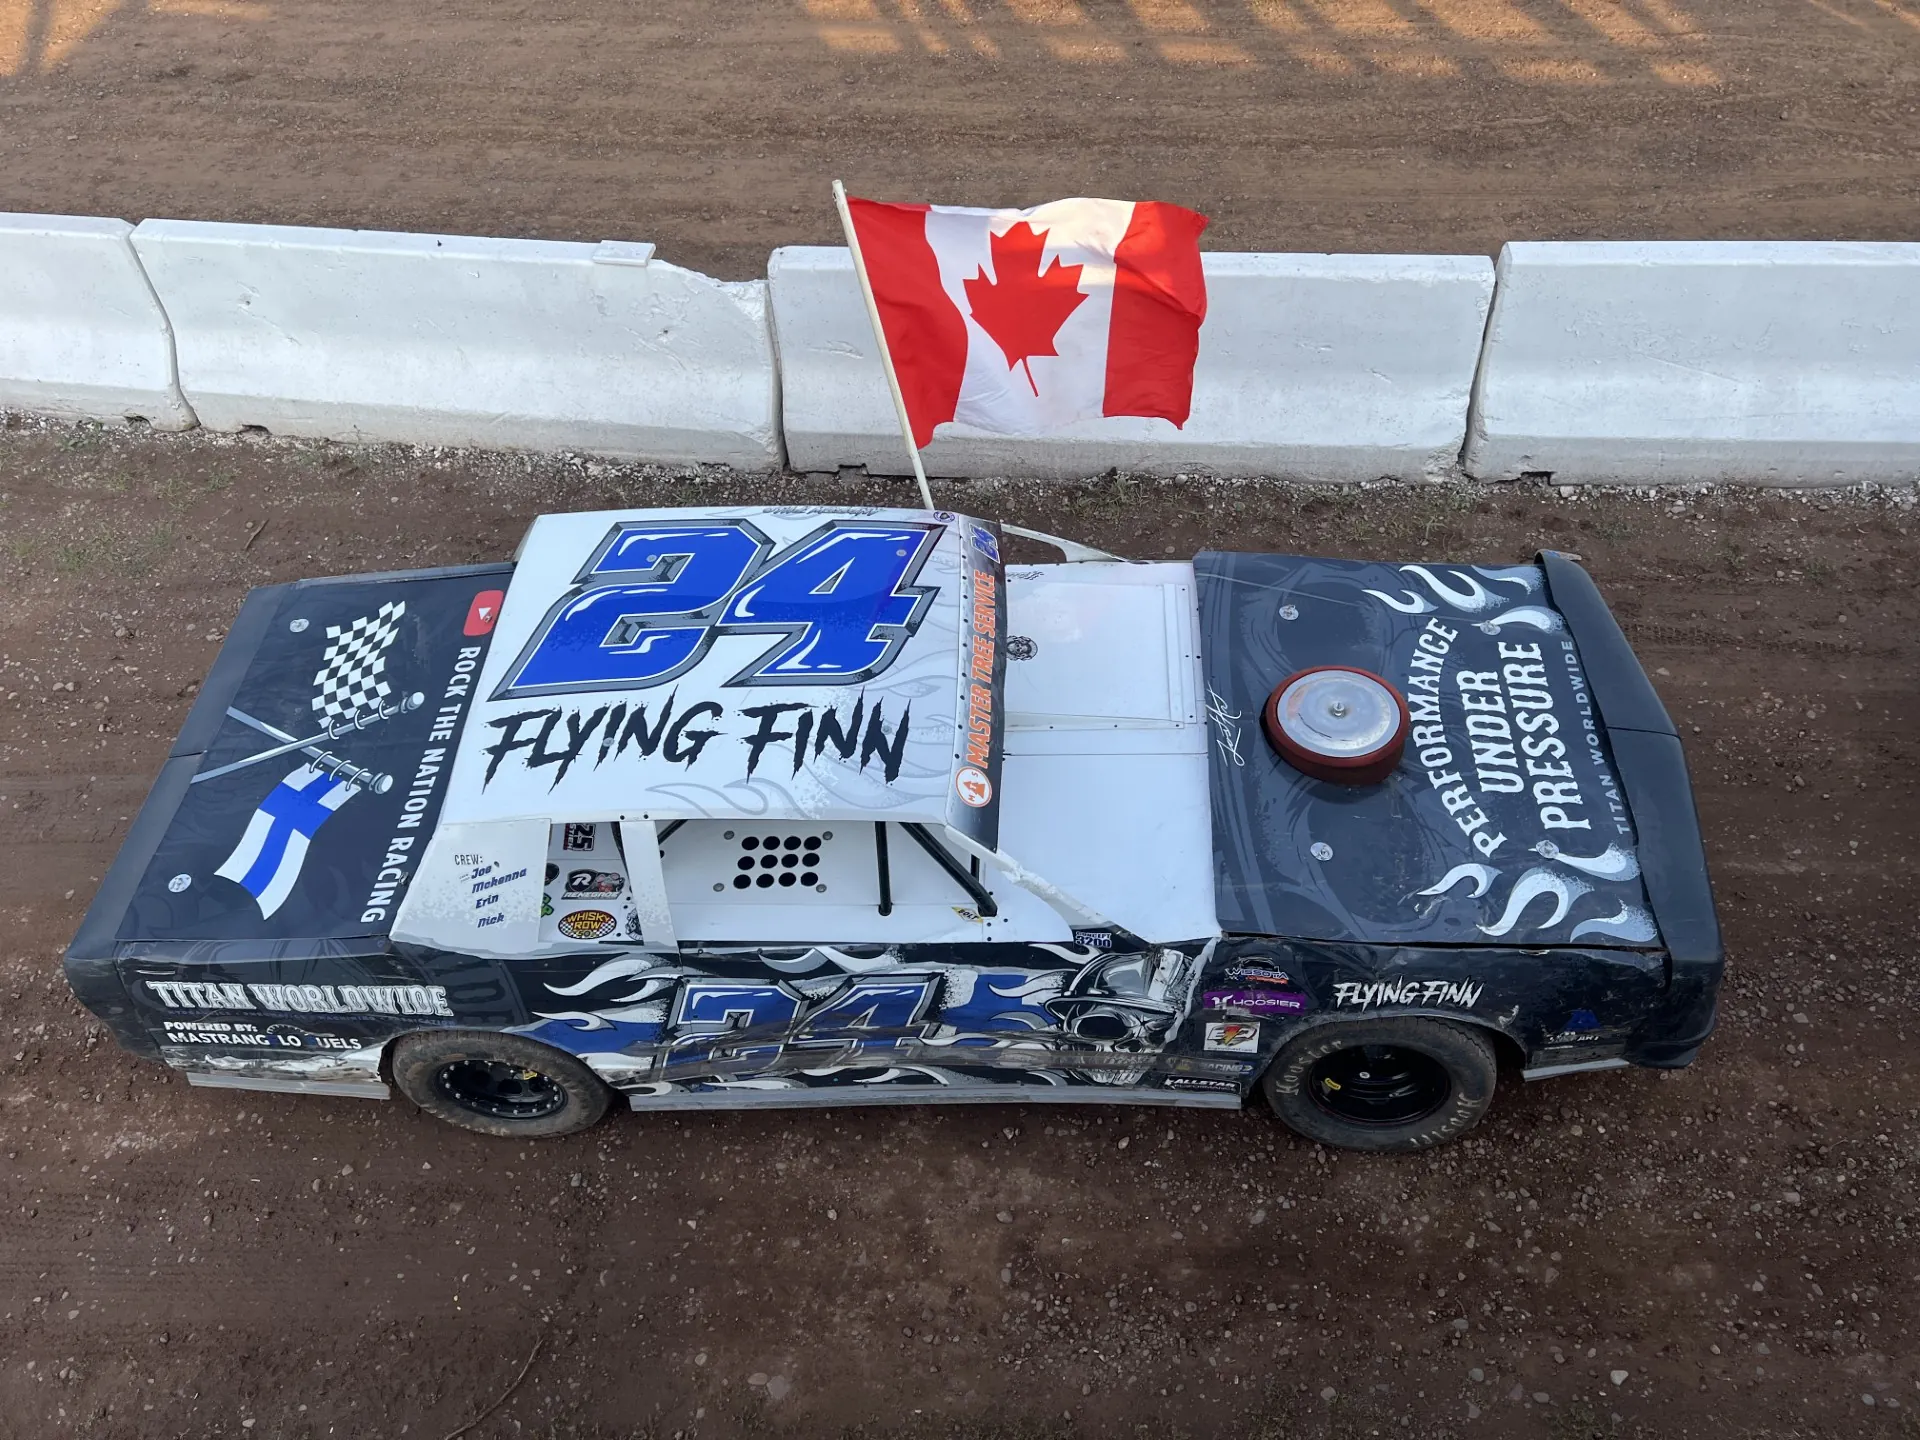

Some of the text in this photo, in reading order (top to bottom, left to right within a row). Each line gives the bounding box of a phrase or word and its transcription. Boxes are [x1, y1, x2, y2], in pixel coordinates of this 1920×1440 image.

[486, 519, 946, 702] 24
[966, 568, 996, 768] MASTER TREE SERVICE
[482, 685, 912, 794] FLYING FINN
[1407, 617, 1508, 858] PERFORMANCE
[1456, 670, 1525, 793] UNDER
[1497, 641, 1591, 830] PRESSURE
[1561, 640, 1631, 835] TITAN WORLDWIDE
[360, 645, 481, 923] ROCK THE NATION RACING
[454, 854, 483, 866] CREW:
[471, 865, 492, 879] Joe
[475, 894, 499, 909] Erin
[567, 912, 610, 923] WHISKY
[574, 921, 601, 929] ROW
[1075, 935, 1112, 948] 3200
[1224, 967, 1289, 980] WISSOTA
[146, 981, 454, 1017] TITAN WORLDWIDE
[1233, 999, 1300, 1009] HOOSIER
[1333, 976, 1485, 1012] FLYING FINN
[163, 1021, 258, 1033] POWERED BY:
[660, 973, 945, 1078] 24
[306, 1035, 362, 1049] UELS
[1173, 1078, 1235, 1087] ALLSTAR
